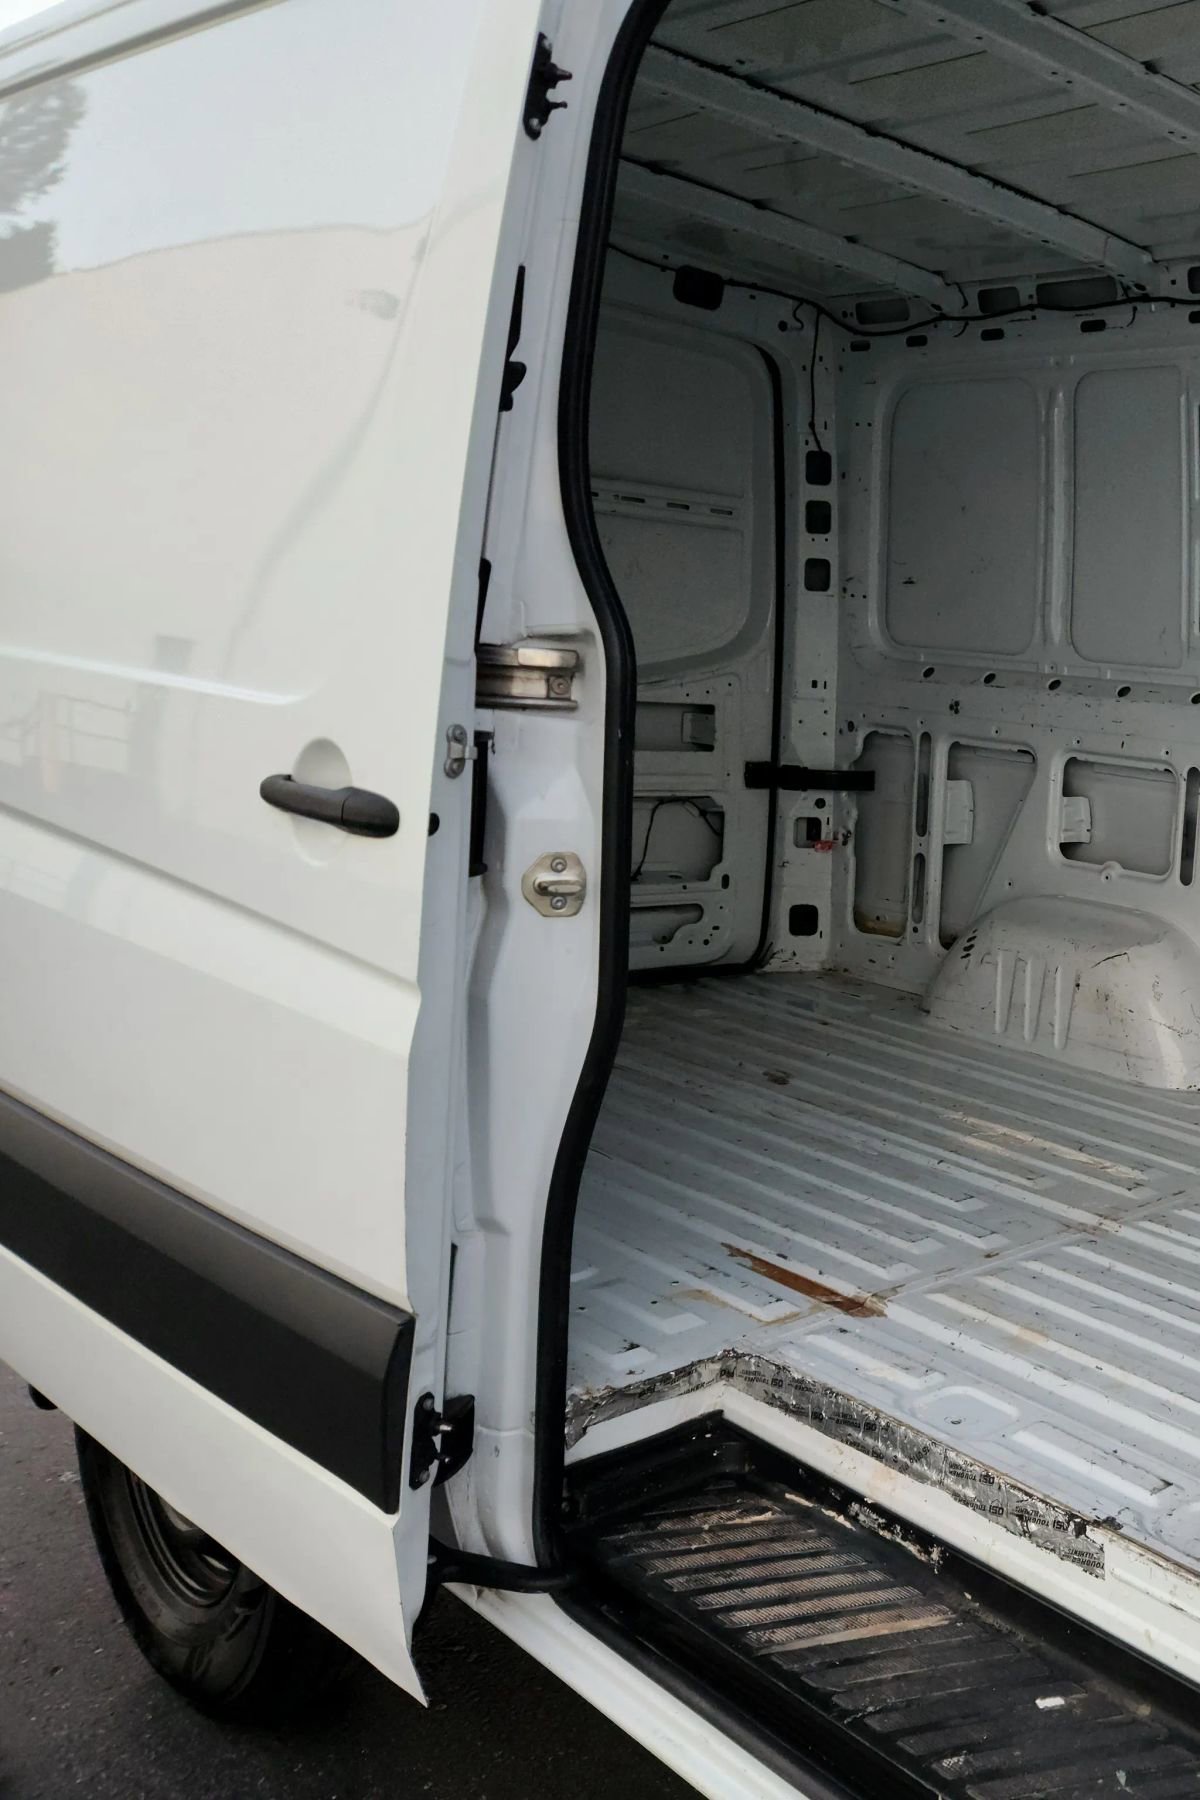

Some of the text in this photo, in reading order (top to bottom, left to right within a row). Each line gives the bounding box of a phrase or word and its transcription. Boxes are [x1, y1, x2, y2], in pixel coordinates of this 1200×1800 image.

[770, 1378, 784, 1388] OSI
[989, 1505, 1004, 1516] OSI
[1071, 1556, 1105, 1569] TOUGHER
